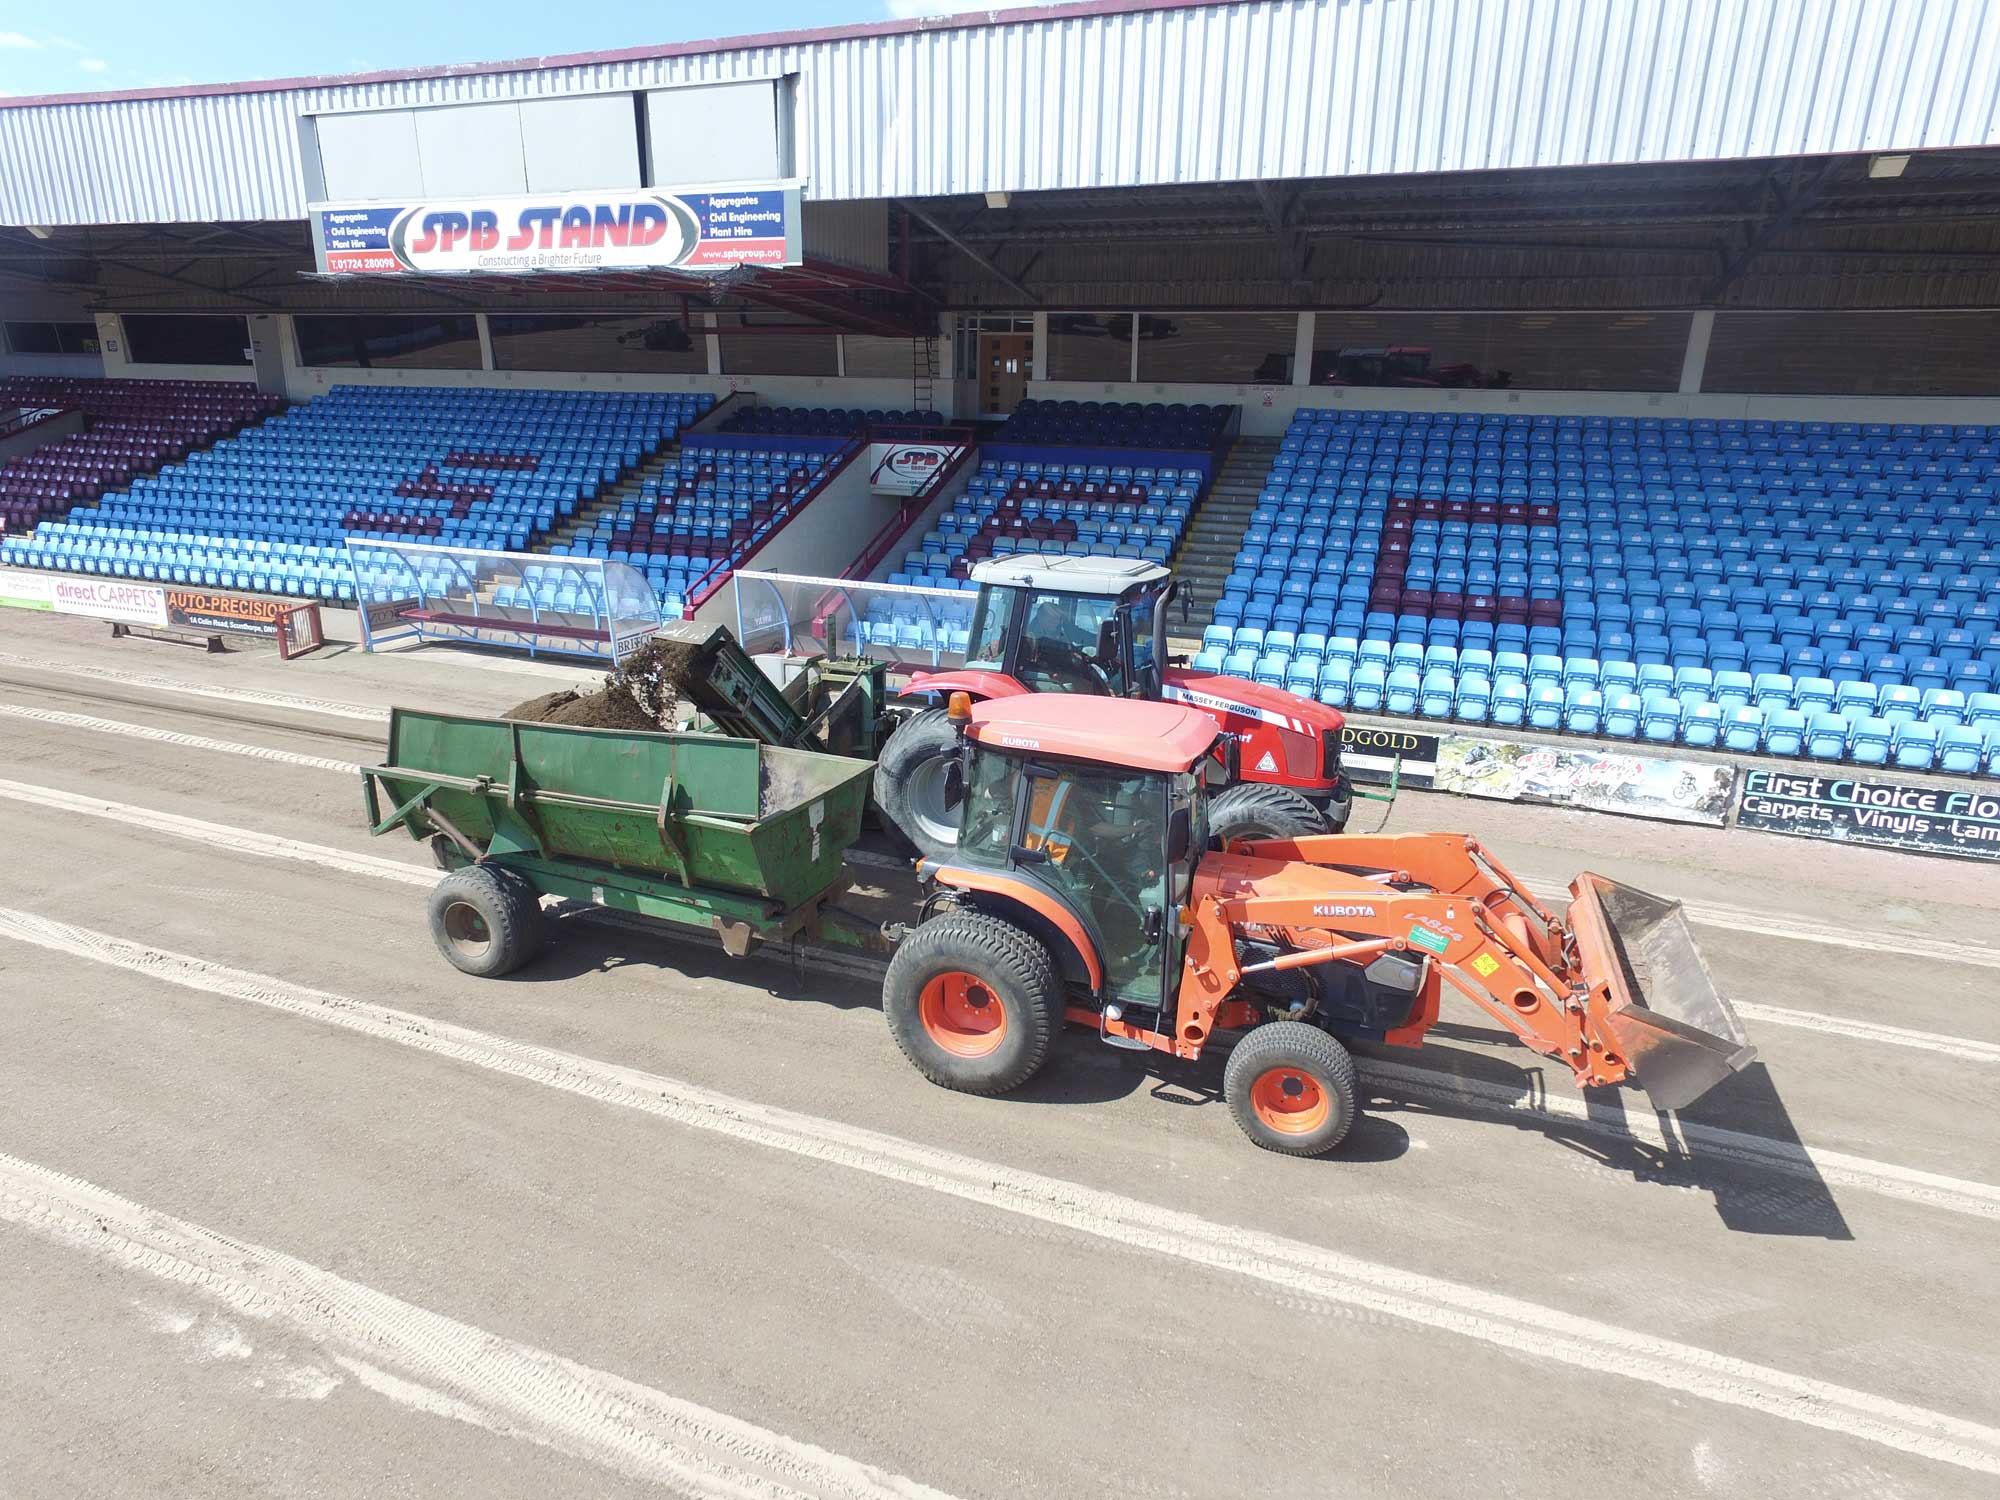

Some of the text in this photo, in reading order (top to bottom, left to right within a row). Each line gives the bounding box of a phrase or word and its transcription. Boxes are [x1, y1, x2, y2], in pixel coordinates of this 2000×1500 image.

[708, 196, 759, 208] Aggregates
[330, 213, 368, 223] Aggregates
[709, 211, 781, 223] Civil Engineering
[331, 226, 386, 237] Civil Engineering
[412, 203, 669, 254] SPB STAND
[710, 226, 752, 237] Plant Hire
[332, 240, 366, 248] Plant Hire
[478, 255, 530, 267] Constructing
[538, 253, 572, 266] Brighter
[573, 252, 602, 264] Future
[702, 248, 782, 259] www.spbgroup.org
[330, 258, 395, 270] T.01724 280098
[896, 451, 939, 465] SPB
[57, 582, 97, 600] direct
[97, 585, 157, 608] CARPETS
[168, 592, 288, 618] AUTO-PRECISION
[617, 633, 655, 653] BRITCO
[1182, 693, 1214, 706] MASSEY
[1214, 700, 1258, 717] FERGUSON
[1002, 736, 1040, 748] KUBOTA
[1341, 728, 1418, 750] DGOLD
[1340, 744, 1355, 753] OR
[1746, 771, 1823, 799] First
[1829, 780, 1937, 811] Choice
[1742, 796, 1833, 821] Carpets
[1854, 808, 1930, 833] Vinyls
[1313, 905, 1377, 917] KUBOTA
